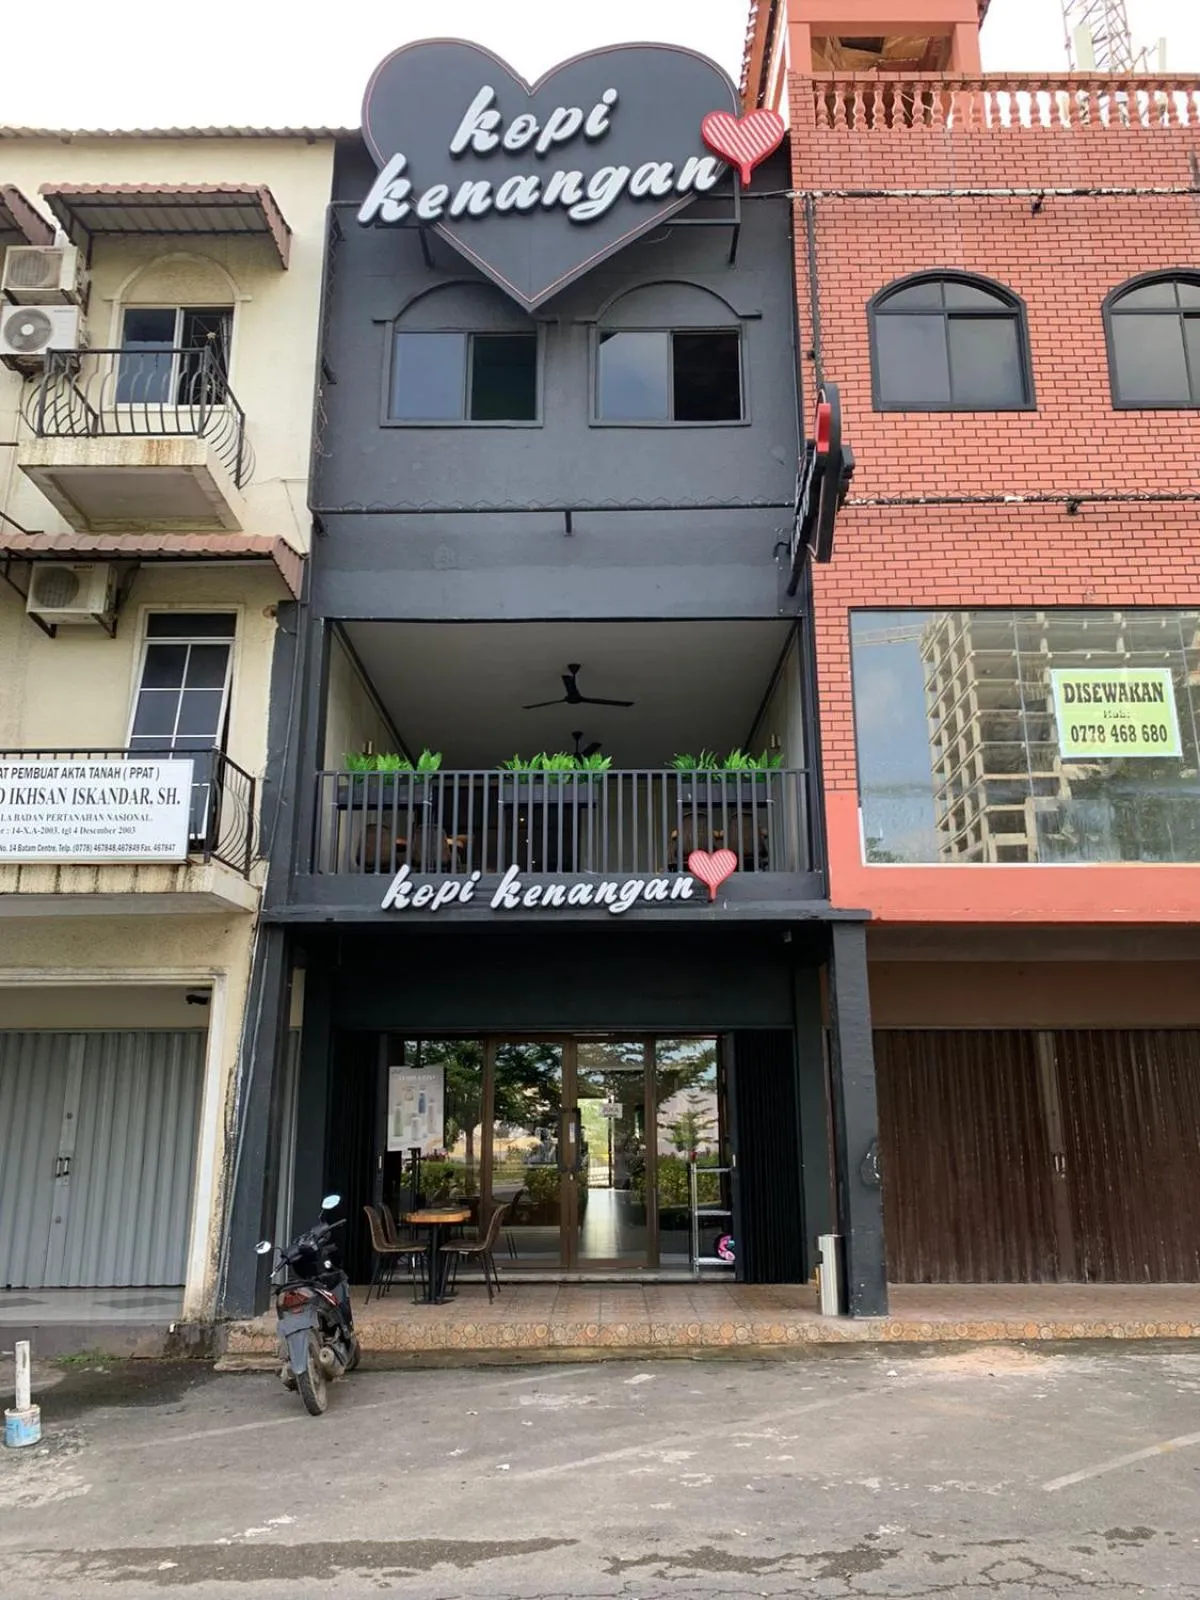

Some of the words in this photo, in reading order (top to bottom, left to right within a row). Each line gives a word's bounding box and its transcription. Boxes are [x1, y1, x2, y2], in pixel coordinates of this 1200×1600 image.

[449, 85, 619, 156] kopi
[357, 152, 719, 224] kenangan
[1063, 682, 1164, 703] DISEWAKAN
[1071, 724, 1106, 743] 0778
[1111, 724, 1137, 743] 468
[1142, 724, 1167, 743] 680
[11, 767, 59, 779] PEMBUAT
[61, 767, 86, 779] AKTA
[89, 767, 121, 779] TANAH
[9, 787, 68, 805] IKHSAN
[157, 787, 181, 805] SH.
[18, 844, 36, 852] Batam
[381, 865, 481, 911] kopi
[490, 865, 694, 915] kenangan
